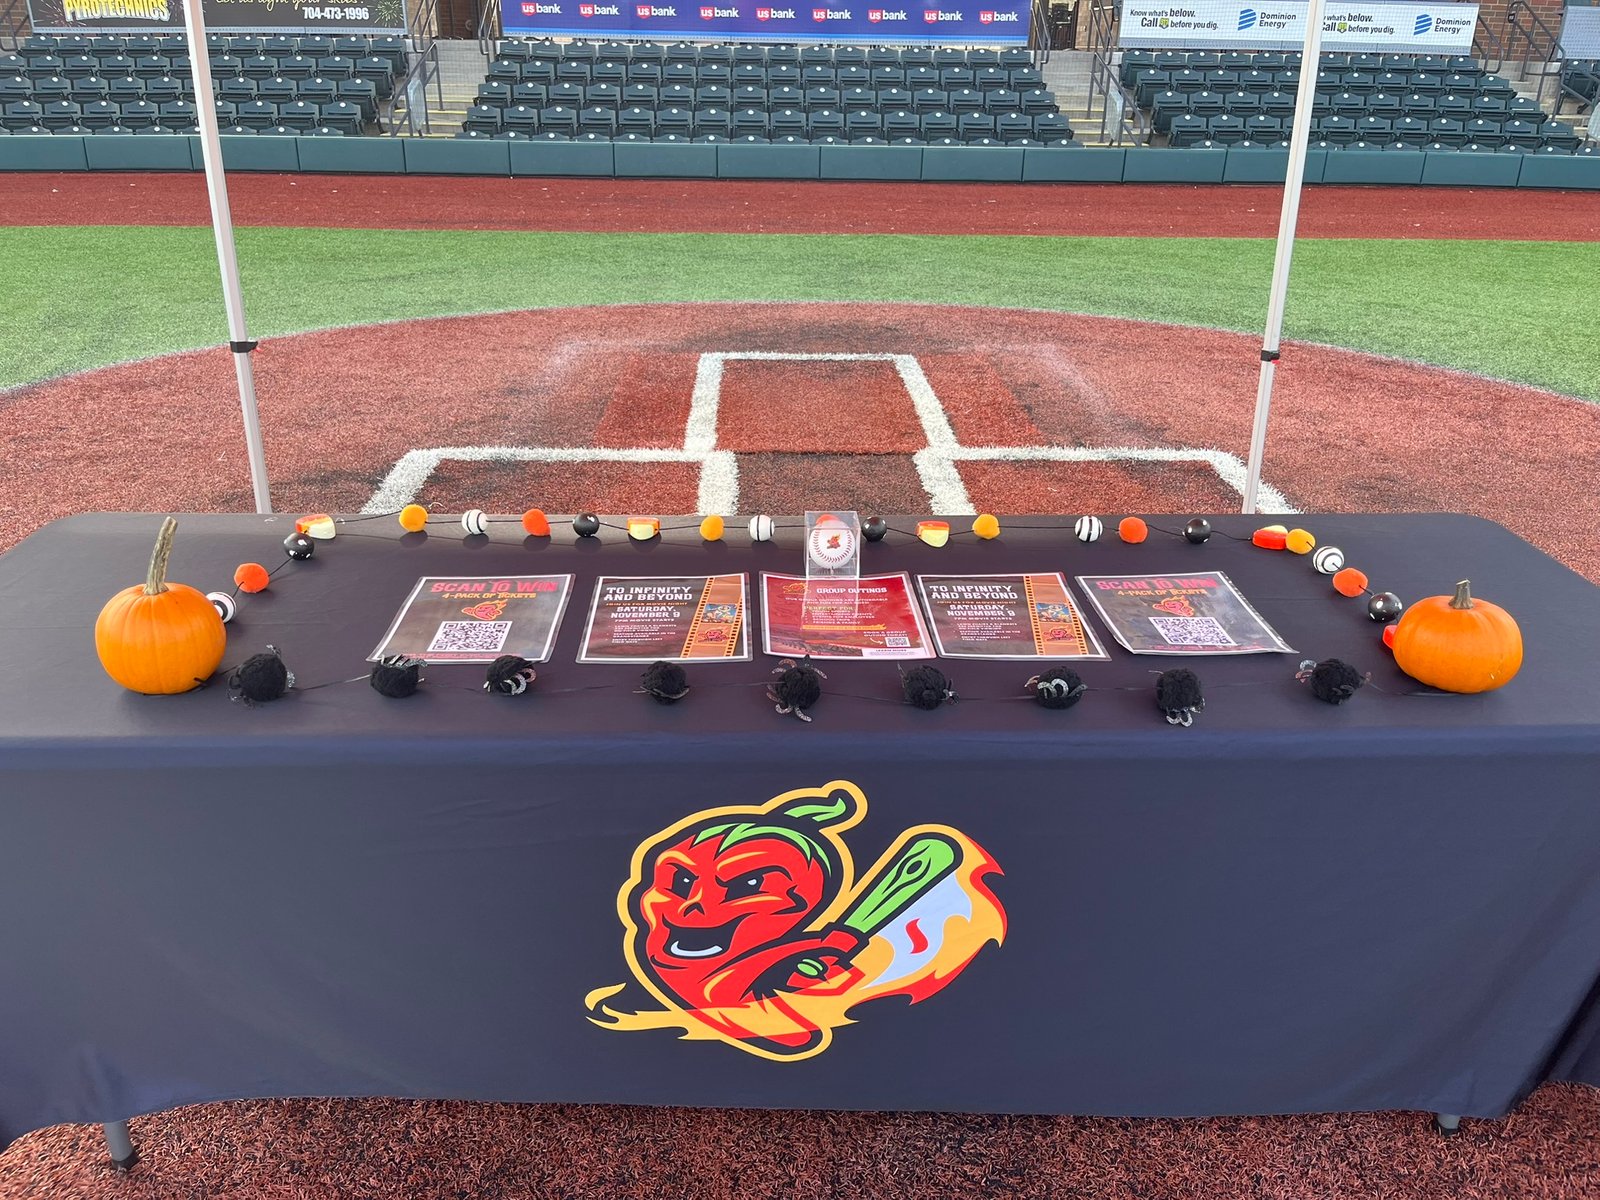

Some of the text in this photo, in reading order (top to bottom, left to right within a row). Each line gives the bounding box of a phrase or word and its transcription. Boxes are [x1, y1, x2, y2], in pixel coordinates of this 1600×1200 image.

[302, 7, 369, 20] 704-473-1996
[522, 3, 561, 14] us bank
[580, 4, 620, 15] us bank
[637, 5, 677, 16] us bank
[701, 7, 740, 17] us bank
[757, 8, 797, 18] us bank
[1130, 8, 1196, 18] Know what's below.
[813, 9, 852, 19] us bank
[869, 10, 908, 20] us bank
[925, 11, 963, 21] us bank
[980, 11, 1019, 22] us bank
[1260, 12, 1297, 20] Dominion
[1326, 14, 1346, 22] what's
[1347, 13, 1373, 23] below.
[1141, 17, 1158, 28] Call
[1170, 20, 1192, 29] before
[1193, 22, 1206, 30] you
[1206, 21, 1219, 30] dig.
[1259, 20, 1286, 28] Energy
[1436, 18, 1471, 26] Dominion
[1347, 24, 1369, 33] before
[1370, 26, 1383, 34] you
[1383, 25, 1395, 35] dig.
[1434, 25, 1461, 34] Energy
[431, 581, 559, 593] SCAN TO WIN
[1096, 581, 1149, 590] SCAN
[1155, 579, 1174, 590] TO
[630, 586, 692, 594] INFINITY
[604, 593, 633, 601] AND
